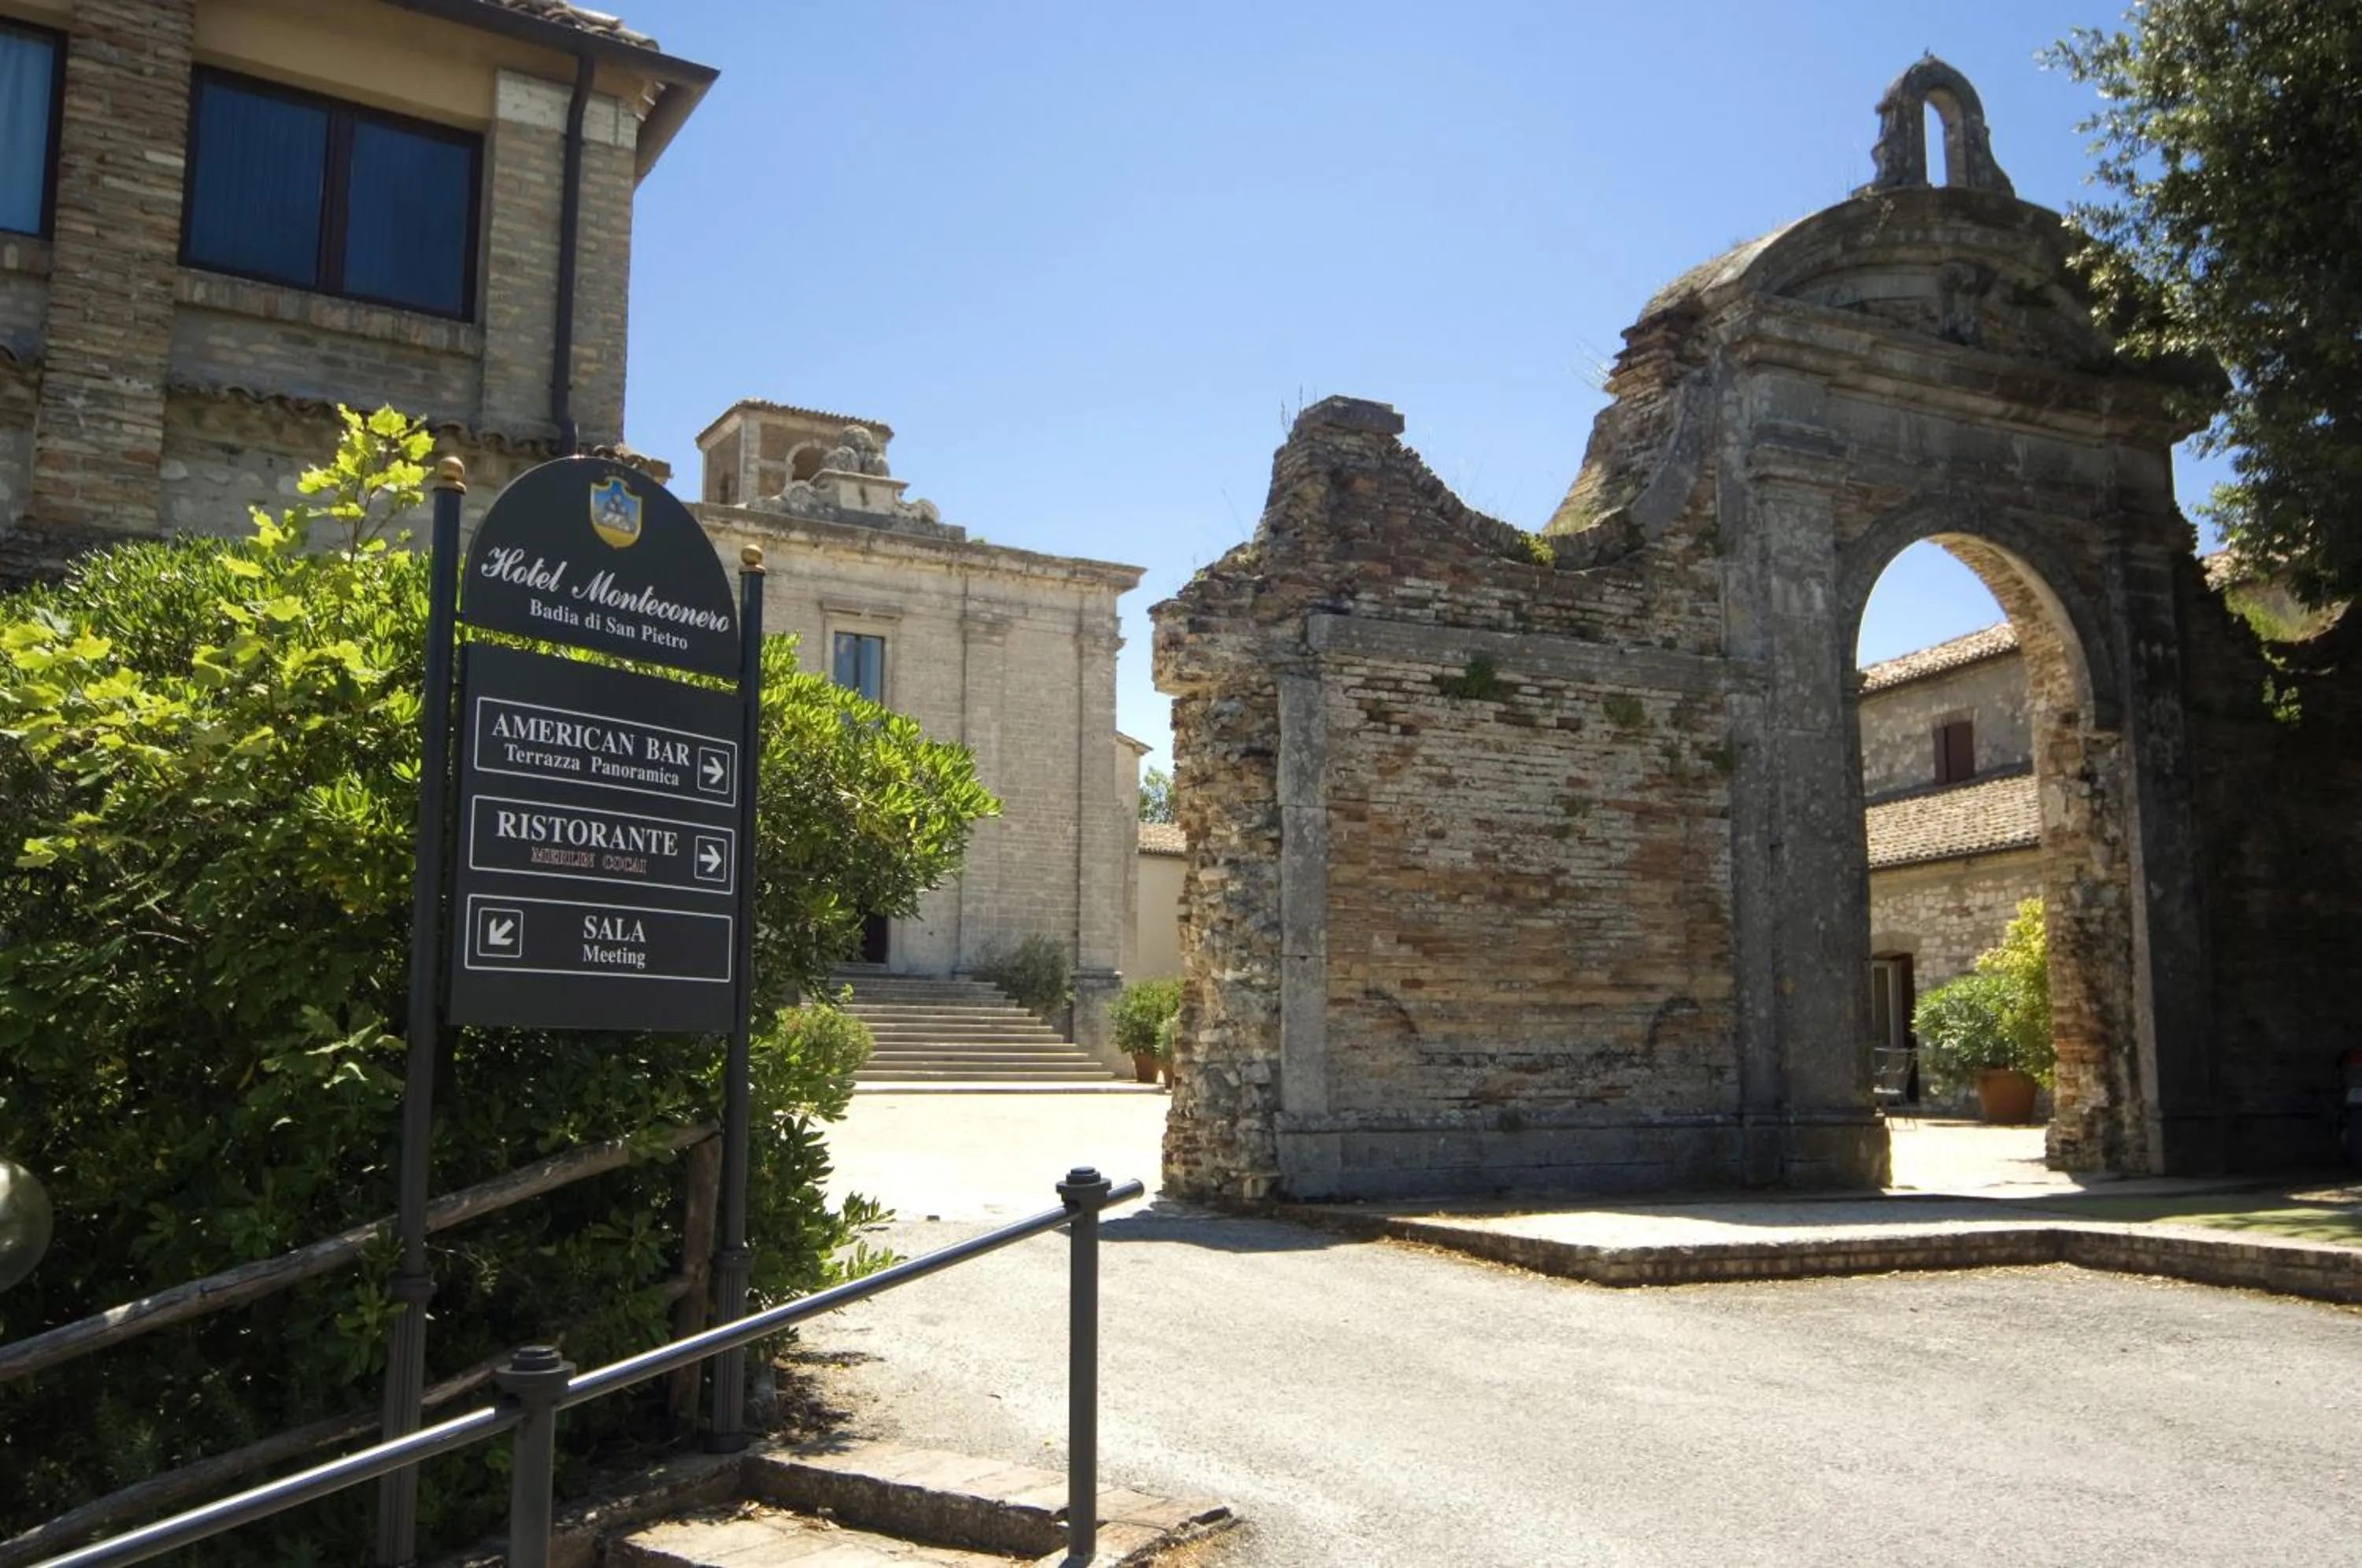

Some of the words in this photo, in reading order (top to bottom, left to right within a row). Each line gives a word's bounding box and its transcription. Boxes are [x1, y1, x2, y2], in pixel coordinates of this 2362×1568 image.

[479, 546, 568, 593] Hotel
[571, 568, 731, 633] Monteconero
[528, 598, 579, 627] Badia
[584, 612, 602, 631] di
[605, 616, 636, 639] San
[641, 623, 689, 652] Pietro
[491, 712, 635, 756] AMERICAN
[646, 737, 690, 767] BAR
[504, 742, 581, 772] Terrazza
[590, 756, 679, 787] Panoramica
[496, 809, 679, 857] RISTORANTE
[583, 914, 647, 943] SALA
[583, 944, 647, 970] Meeting
